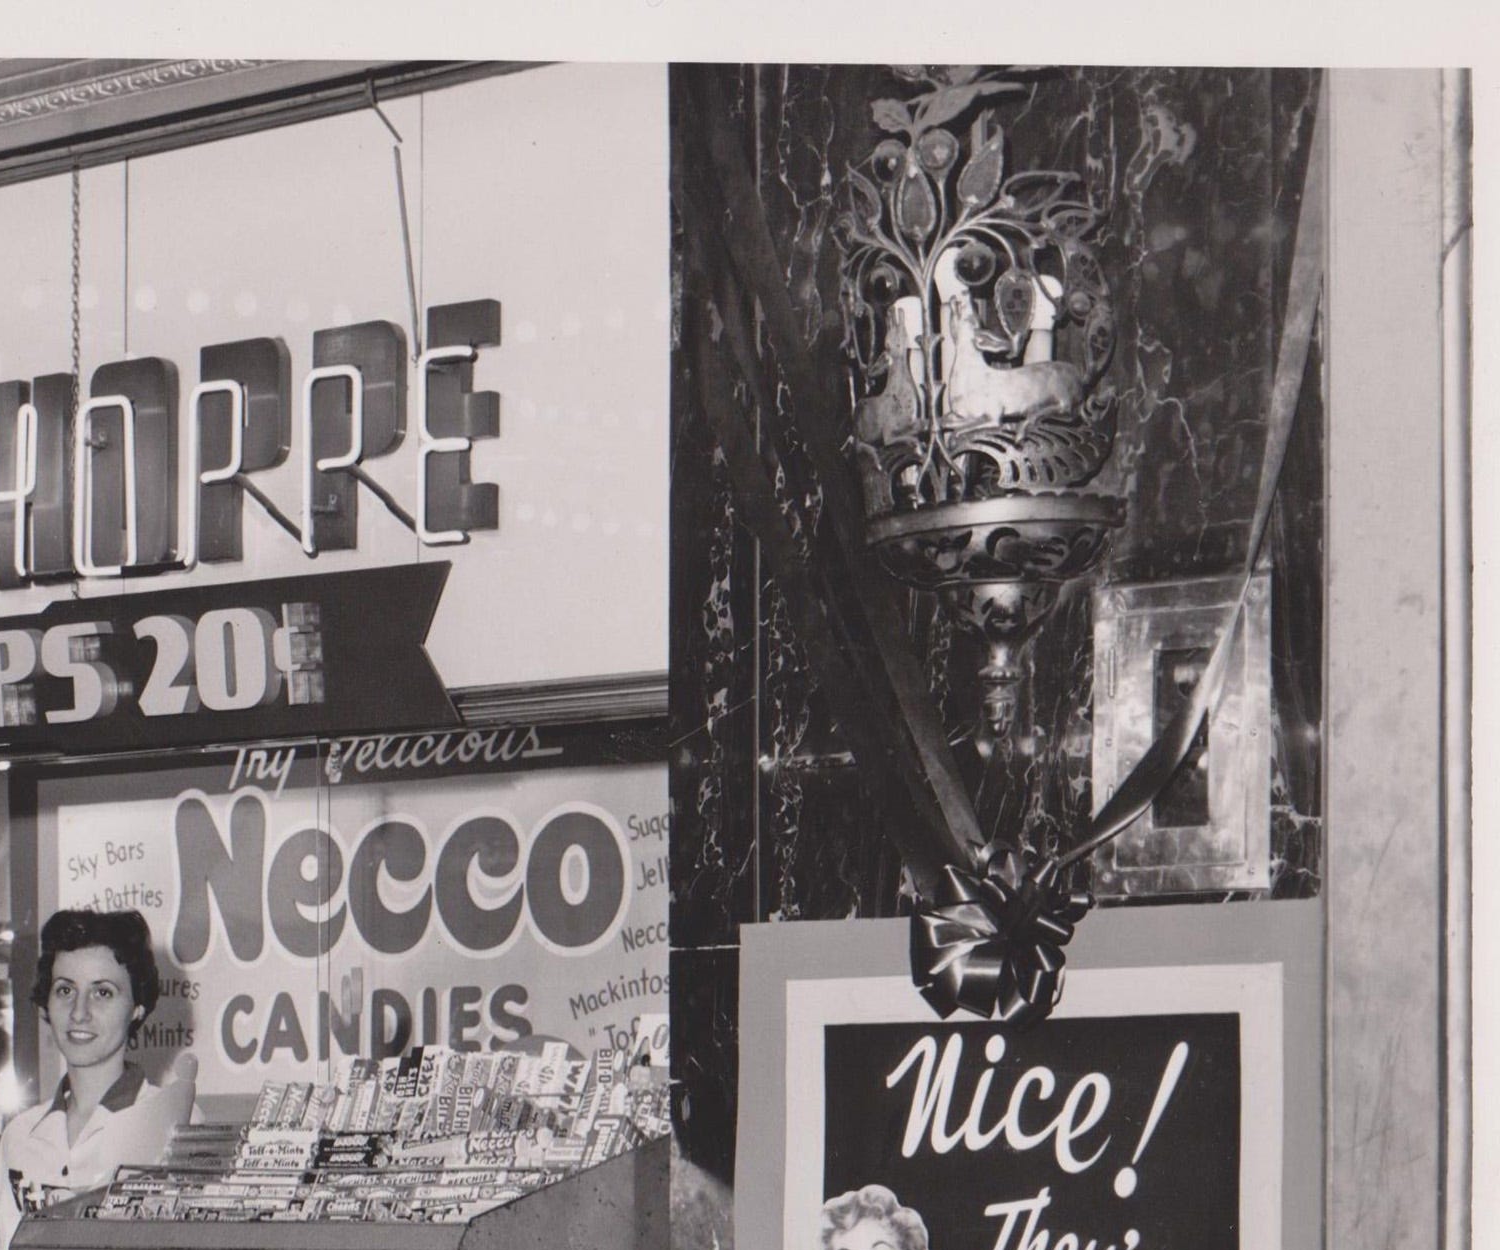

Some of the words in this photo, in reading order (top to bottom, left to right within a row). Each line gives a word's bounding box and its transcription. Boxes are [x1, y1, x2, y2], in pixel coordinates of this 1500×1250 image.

[229, 748, 296, 799] Try
[68, 853, 99, 882] Sky
[105, 841, 144, 866] Bars
[170, 789, 627, 964] Necco
[105, 882, 164, 910] Patties
[143, 1022, 195, 1050] Mints
[220, 984, 533, 1066] CANDIES
[885, 1032, 1189, 1199] Nice!
[469, 1134, 514, 1152] Necco
